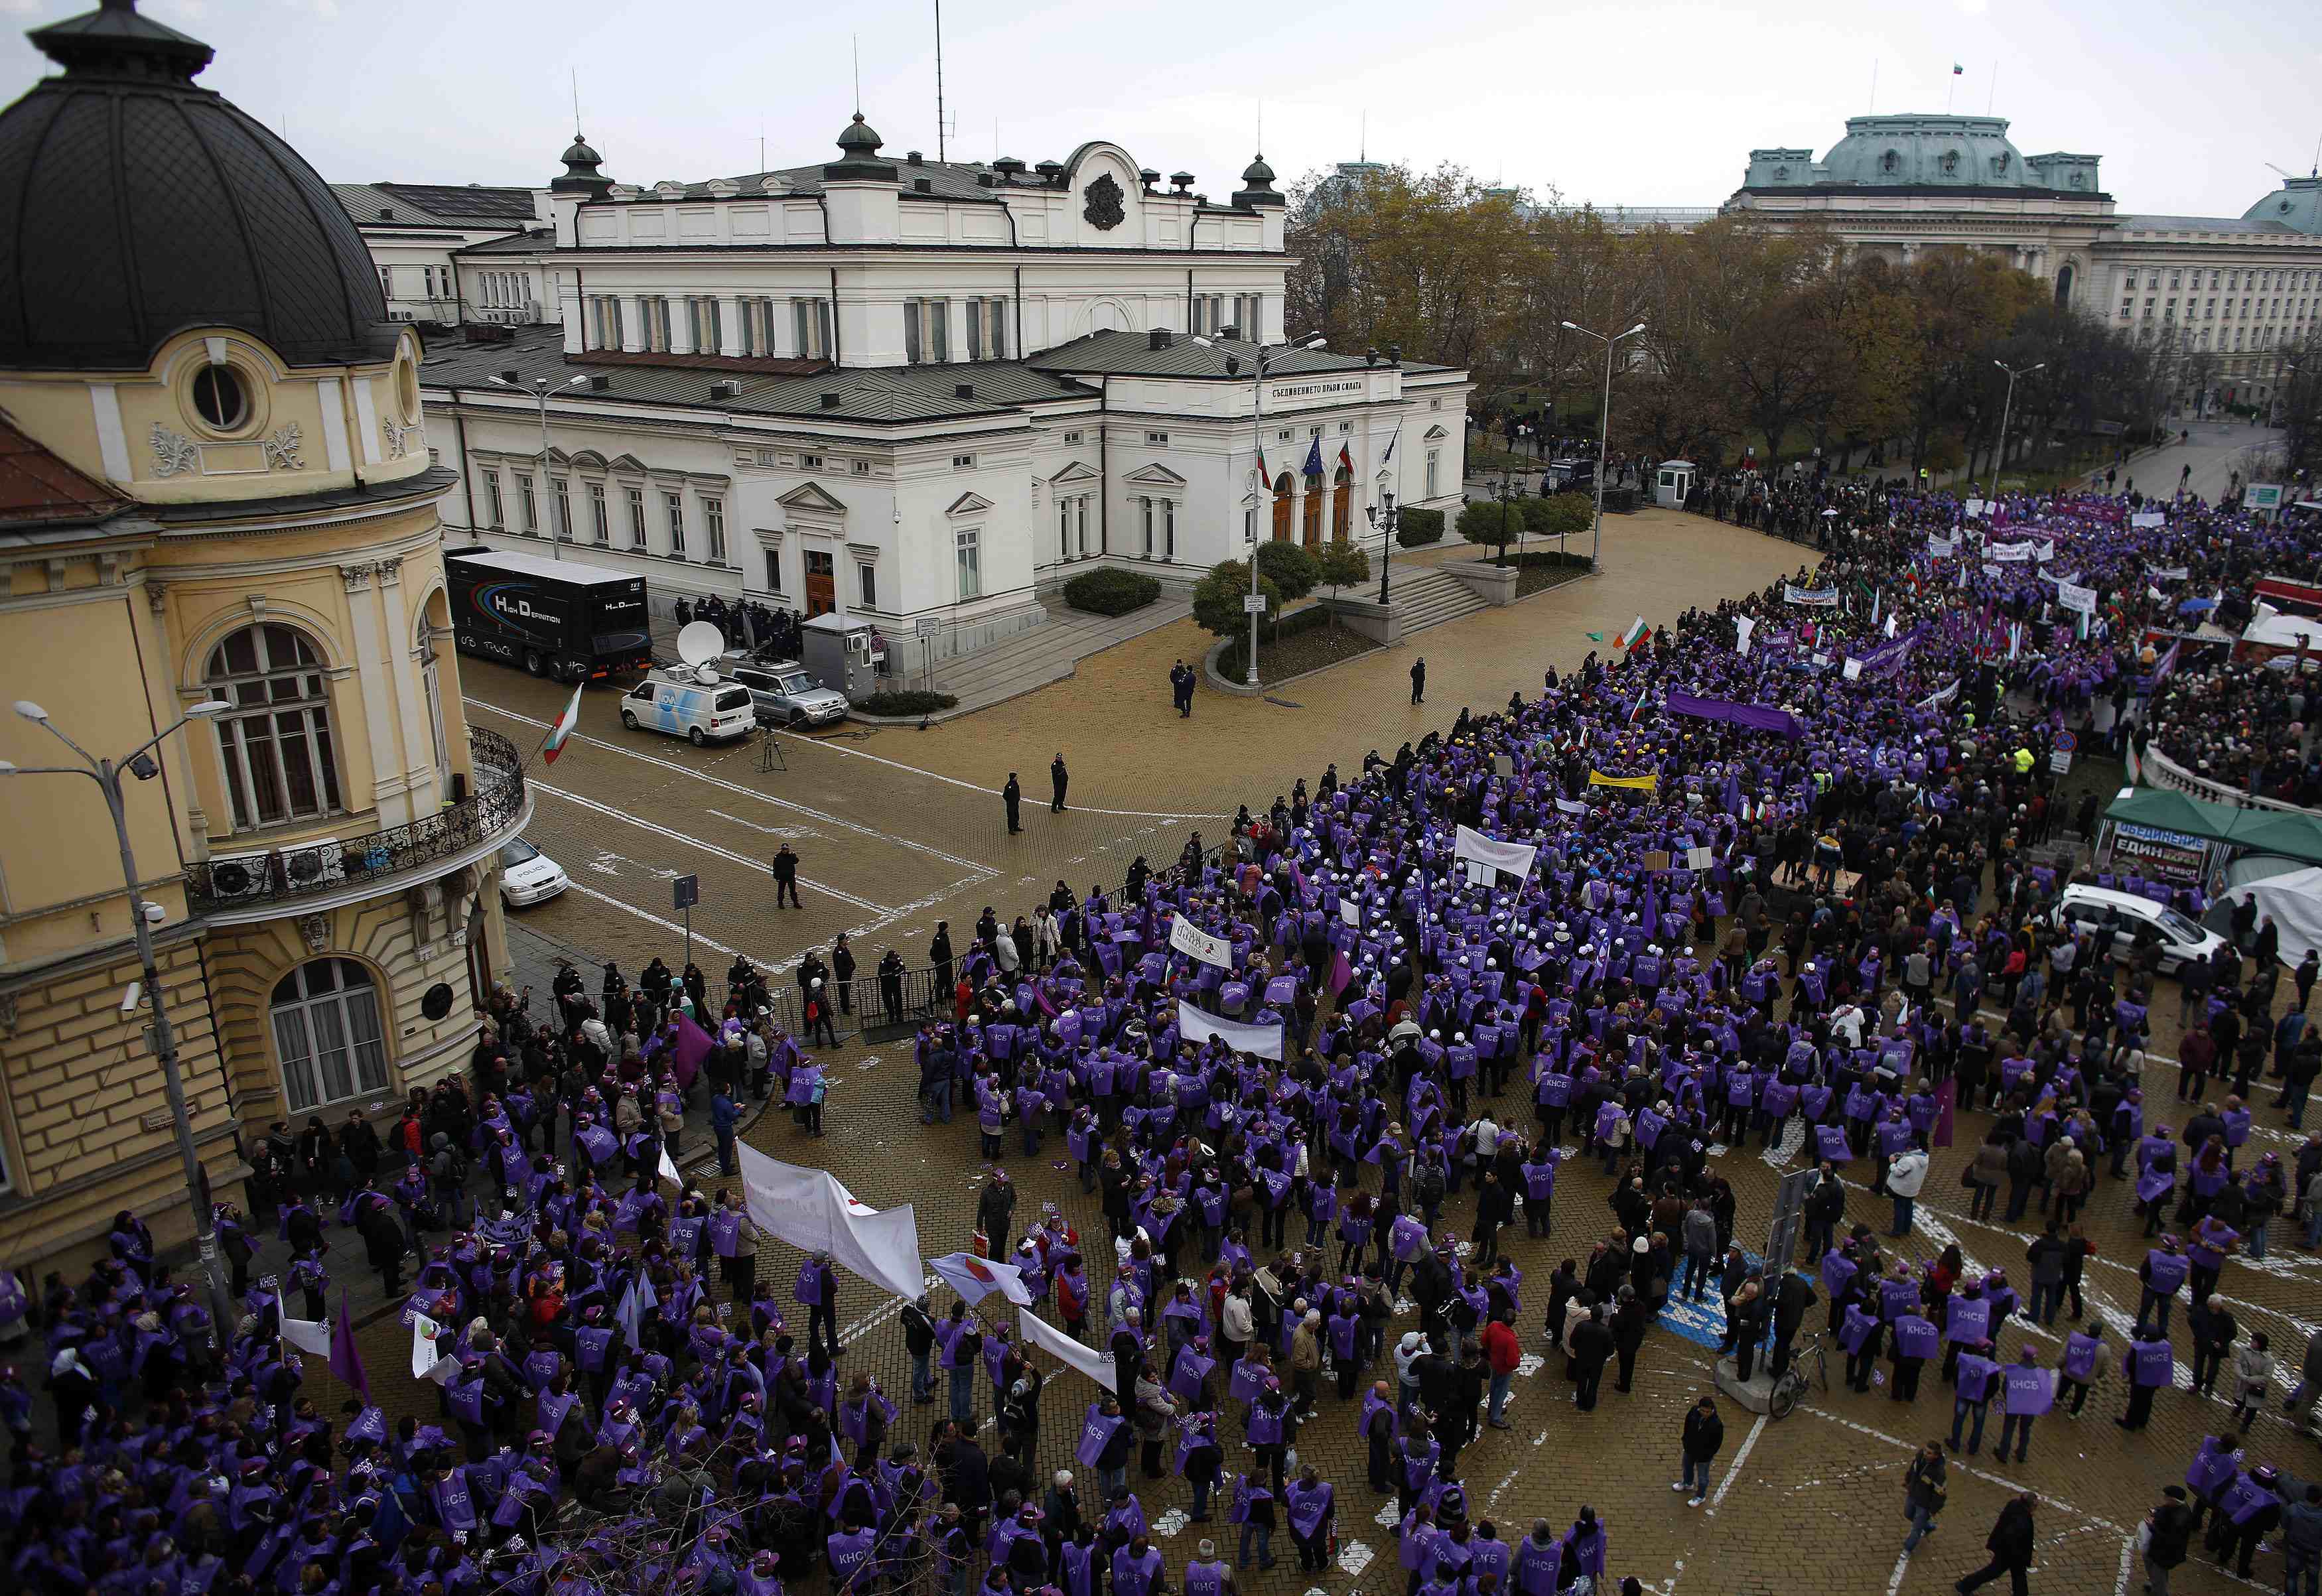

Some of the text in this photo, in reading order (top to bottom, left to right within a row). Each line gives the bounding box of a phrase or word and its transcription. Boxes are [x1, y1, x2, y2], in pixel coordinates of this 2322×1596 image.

[1273, 382, 1361, 397] СЪЕДИНЕНИЕТО ПРАВИ СИЛАТА
[495, 596, 561, 624] HIGH DEFINITION
[2116, 838, 2163, 858] ЕДИН
[517, 864, 547, 878] POLICE
[1479, 1033, 1497, 1042] КНСБ
[1718, 1031, 1730, 1040] КНС
[792, 1077, 809, 1086] КНСБ
[1181, 1084, 1201, 1093] КНСБ
[590, 1132, 604, 1147] КНСБ
[1042, 1201, 1056, 1212] КНСБ
[1204, 1197, 1222, 1207] КНСБ
[259, 1276, 278, 1288] КНСБ
[411, 1296, 429, 1309] КНСБ
[1890, 1292, 1914, 1301] КНСБ
[717, 1302, 732, 1315] КНСБ
[1958, 1310, 1985, 1322] КНСБ
[318, 1317, 330, 1333] КНС
[1907, 1325, 1935, 1336] КНСБ
[1099, 1351, 1115, 1363] КНСБ
[2143, 1354, 2168, 1363] КНСБ
[1182, 1361, 1199, 1379] КНСБ
[1237, 1366, 1257, 1382] КНСБ
[616, 1378, 641, 1392] КНСБ
[2010, 1379, 2039, 1390] КНСБ
[450, 1392, 473, 1402] КНСБ
[541, 1399, 559, 1417] КНСБ
[508, 1486, 525, 1498] КНС
[1000, 1532, 1014, 1546] КНС
[1581, 1544, 1598, 1558] КНС
[839, 1551, 864, 1565] КНС
[1194, 1581, 1215, 1591] КНС
